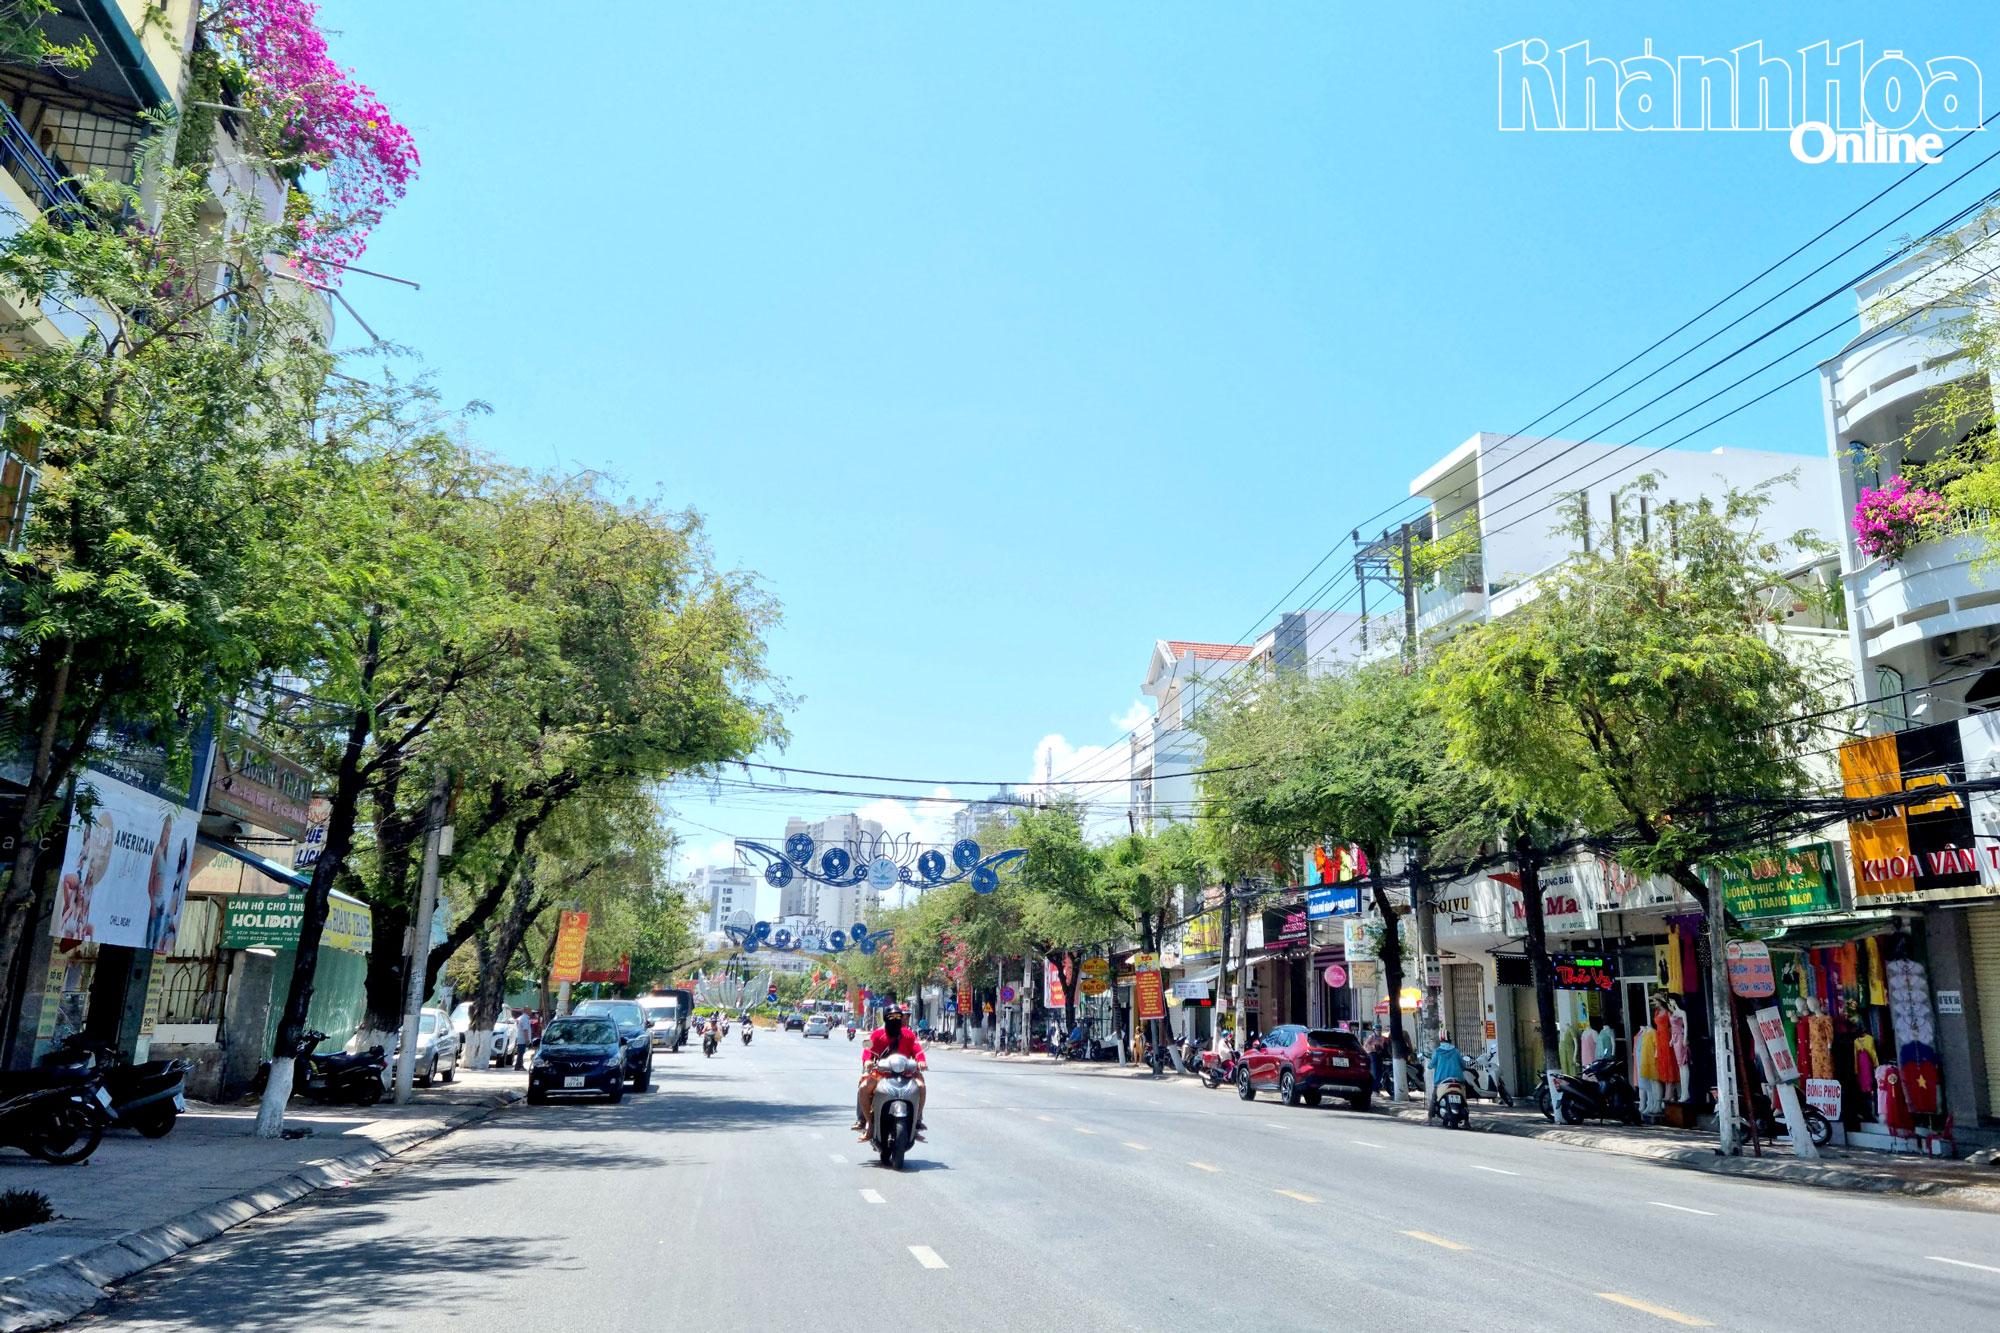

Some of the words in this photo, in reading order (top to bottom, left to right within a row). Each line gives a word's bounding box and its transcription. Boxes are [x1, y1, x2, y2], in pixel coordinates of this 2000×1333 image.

[114, 830, 155, 856] AMERICAN
[1927, 843, 1977, 875] VÂN
[266, 901, 286, 911] CHO
[1758, 896, 1787, 909] TRANG
[232, 913, 303, 929] HOLIDAY
